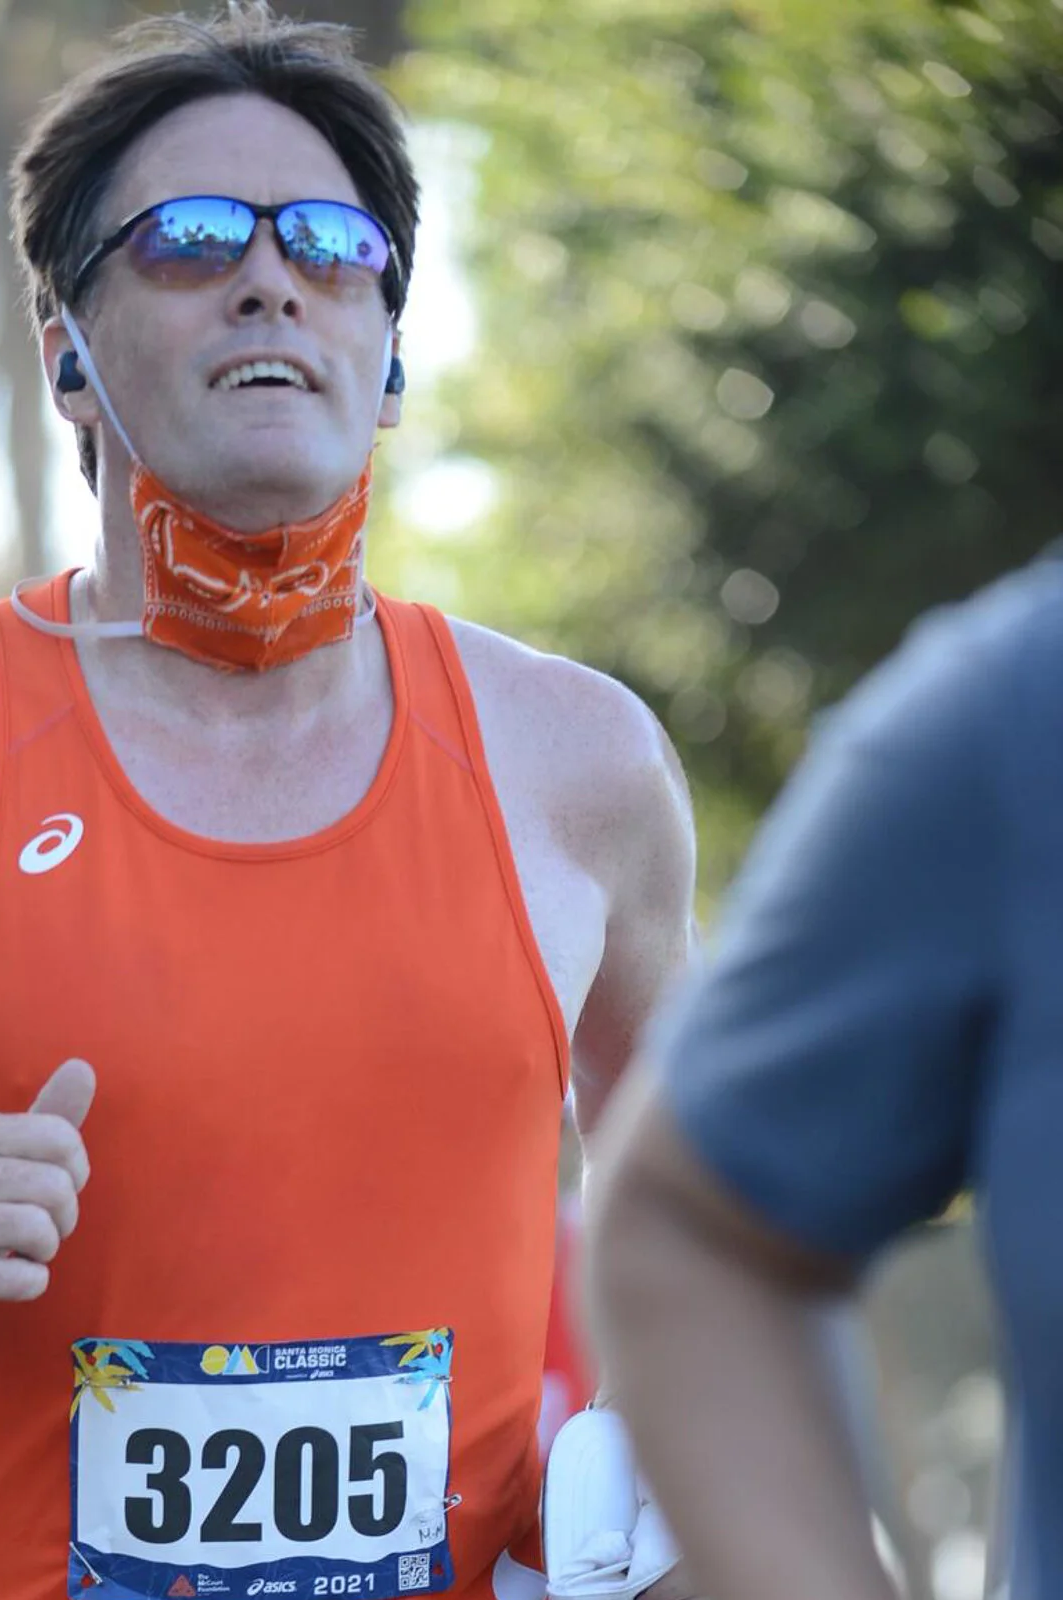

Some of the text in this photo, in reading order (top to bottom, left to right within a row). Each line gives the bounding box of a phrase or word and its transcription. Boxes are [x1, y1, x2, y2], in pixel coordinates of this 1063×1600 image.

[275, 1345, 346, 1356] SANTA MONICA
[274, 1354, 346, 1370] CLASSIC
[124, 1421, 408, 1546] 3205
[314, 1573, 375, 1595] 2021
